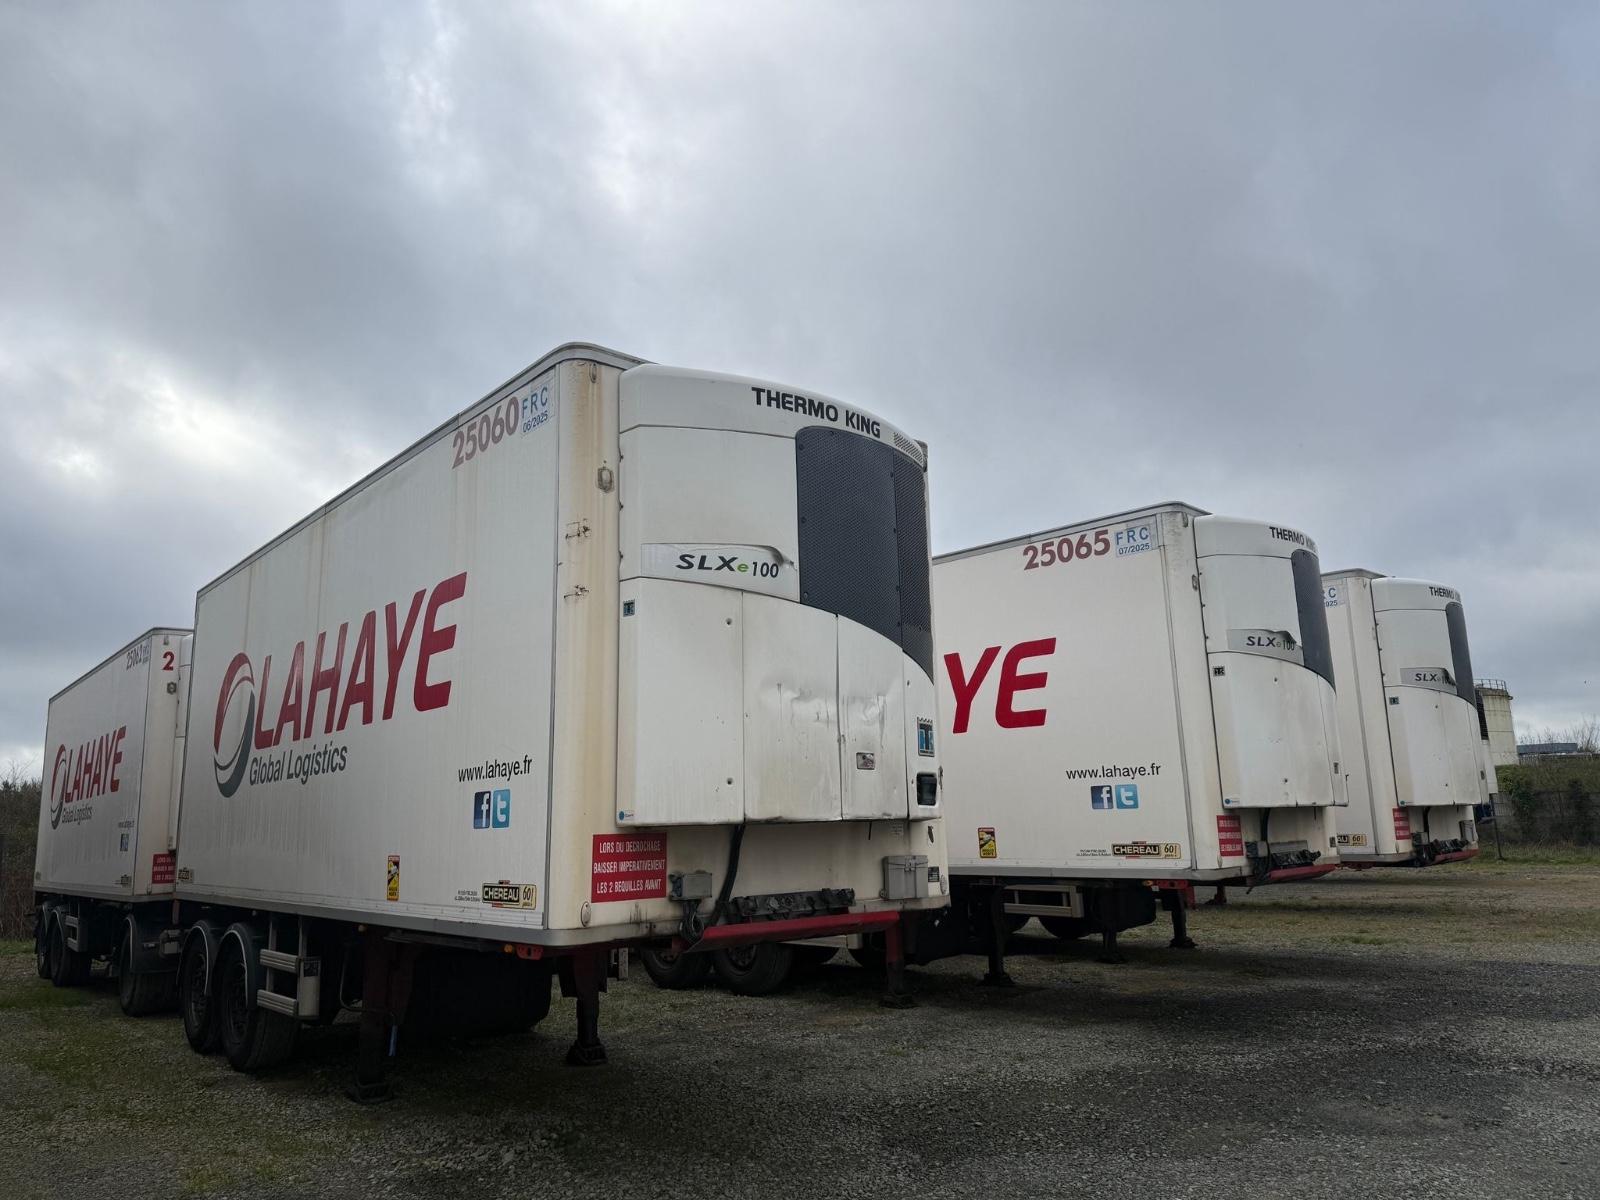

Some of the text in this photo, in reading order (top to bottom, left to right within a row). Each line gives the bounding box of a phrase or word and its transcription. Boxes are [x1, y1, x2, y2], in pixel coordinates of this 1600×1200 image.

[522, 386, 548, 419] FRC
[751, 387, 881, 438] THERMO KING
[523, 410, 548, 433] 06/2025
[452, 396, 519, 469] 25060
[1116, 527, 1149, 545] FRC
[1269, 526, 1305, 546] THERMO
[1022, 529, 1111, 571] 25065
[1118, 542, 1150, 555] 07/2025
[675, 553, 779, 578] SLXe 100
[162, 651, 175, 671] 2
[255, 571, 468, 750] LAHAYE
[65, 725, 127, 804] LAHAYE
[249, 740, 348, 786] Global Logistics
[458, 754, 533, 783] www.lahaye.fr
[1065, 763, 1162, 780] www.lahaye.fr
[599, 840, 661, 854] LORS DU DECROCHAGE
[1113, 845, 1159, 855] CHEREAU
[593, 859, 666, 874] BAISSER IMPERATIVEMENT
[482, 886, 520, 901] CHEREAU
[596, 878, 662, 894] LES 2 BEQUILLES AVANT
